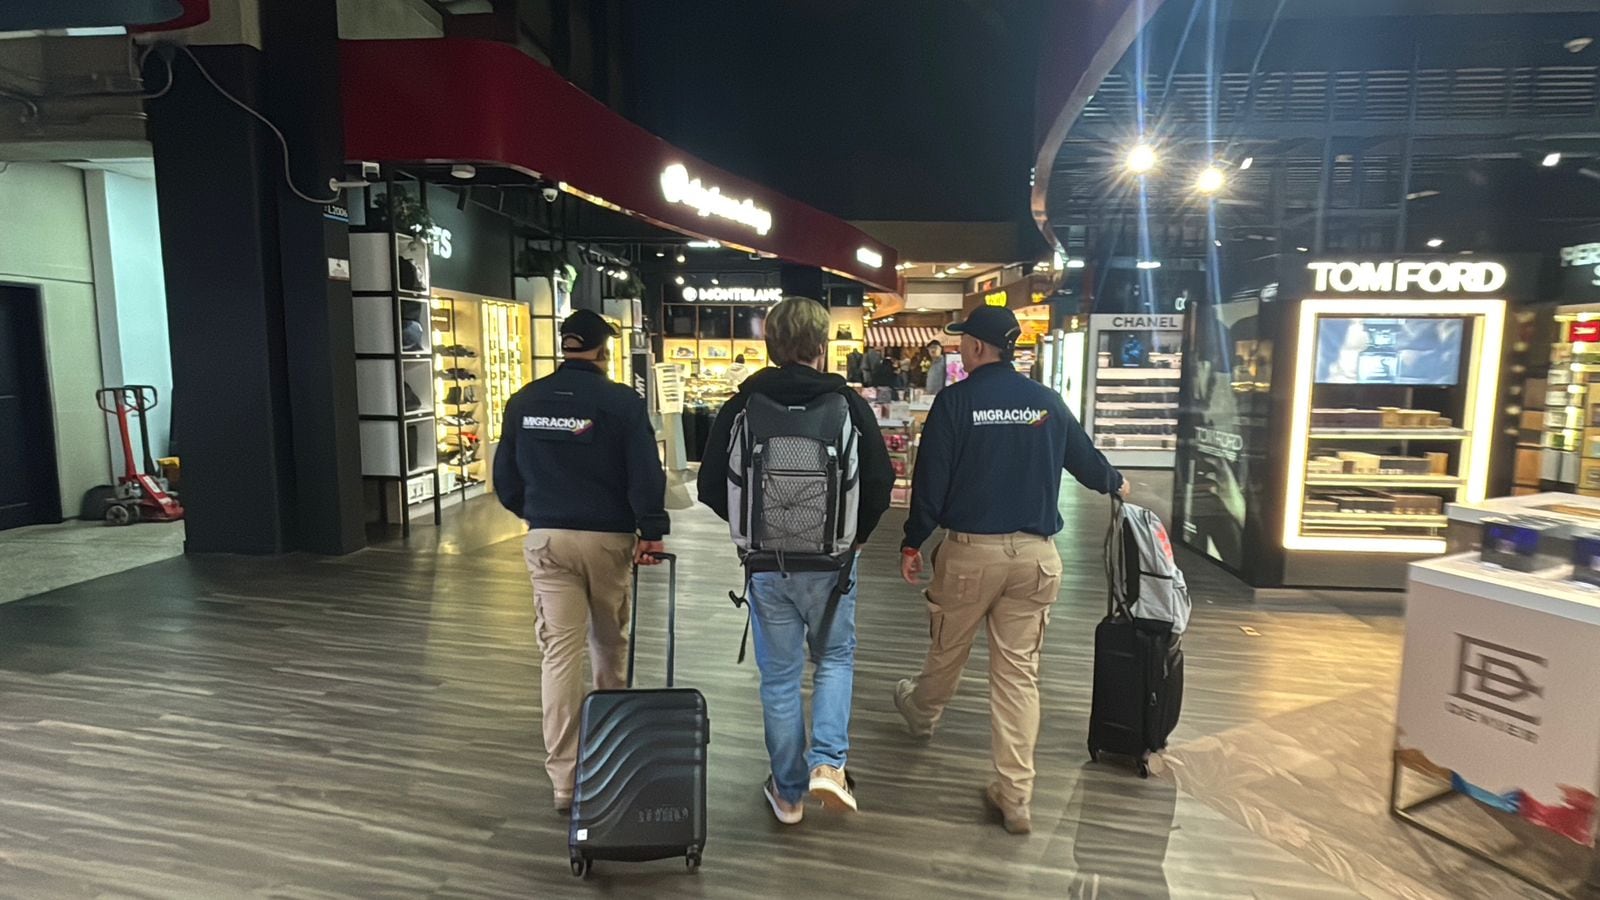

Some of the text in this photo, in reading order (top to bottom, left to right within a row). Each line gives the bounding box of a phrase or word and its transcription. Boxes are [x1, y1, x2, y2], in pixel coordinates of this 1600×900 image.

[1307, 262, 1507, 292] TOM FORD
[698, 288, 783, 303] MONTBLANC
[1112, 316, 1178, 328] CHANEL
[972, 406, 1041, 422] MIGRACIÓN
[522, 415, 586, 430] MIGRACIÓN
